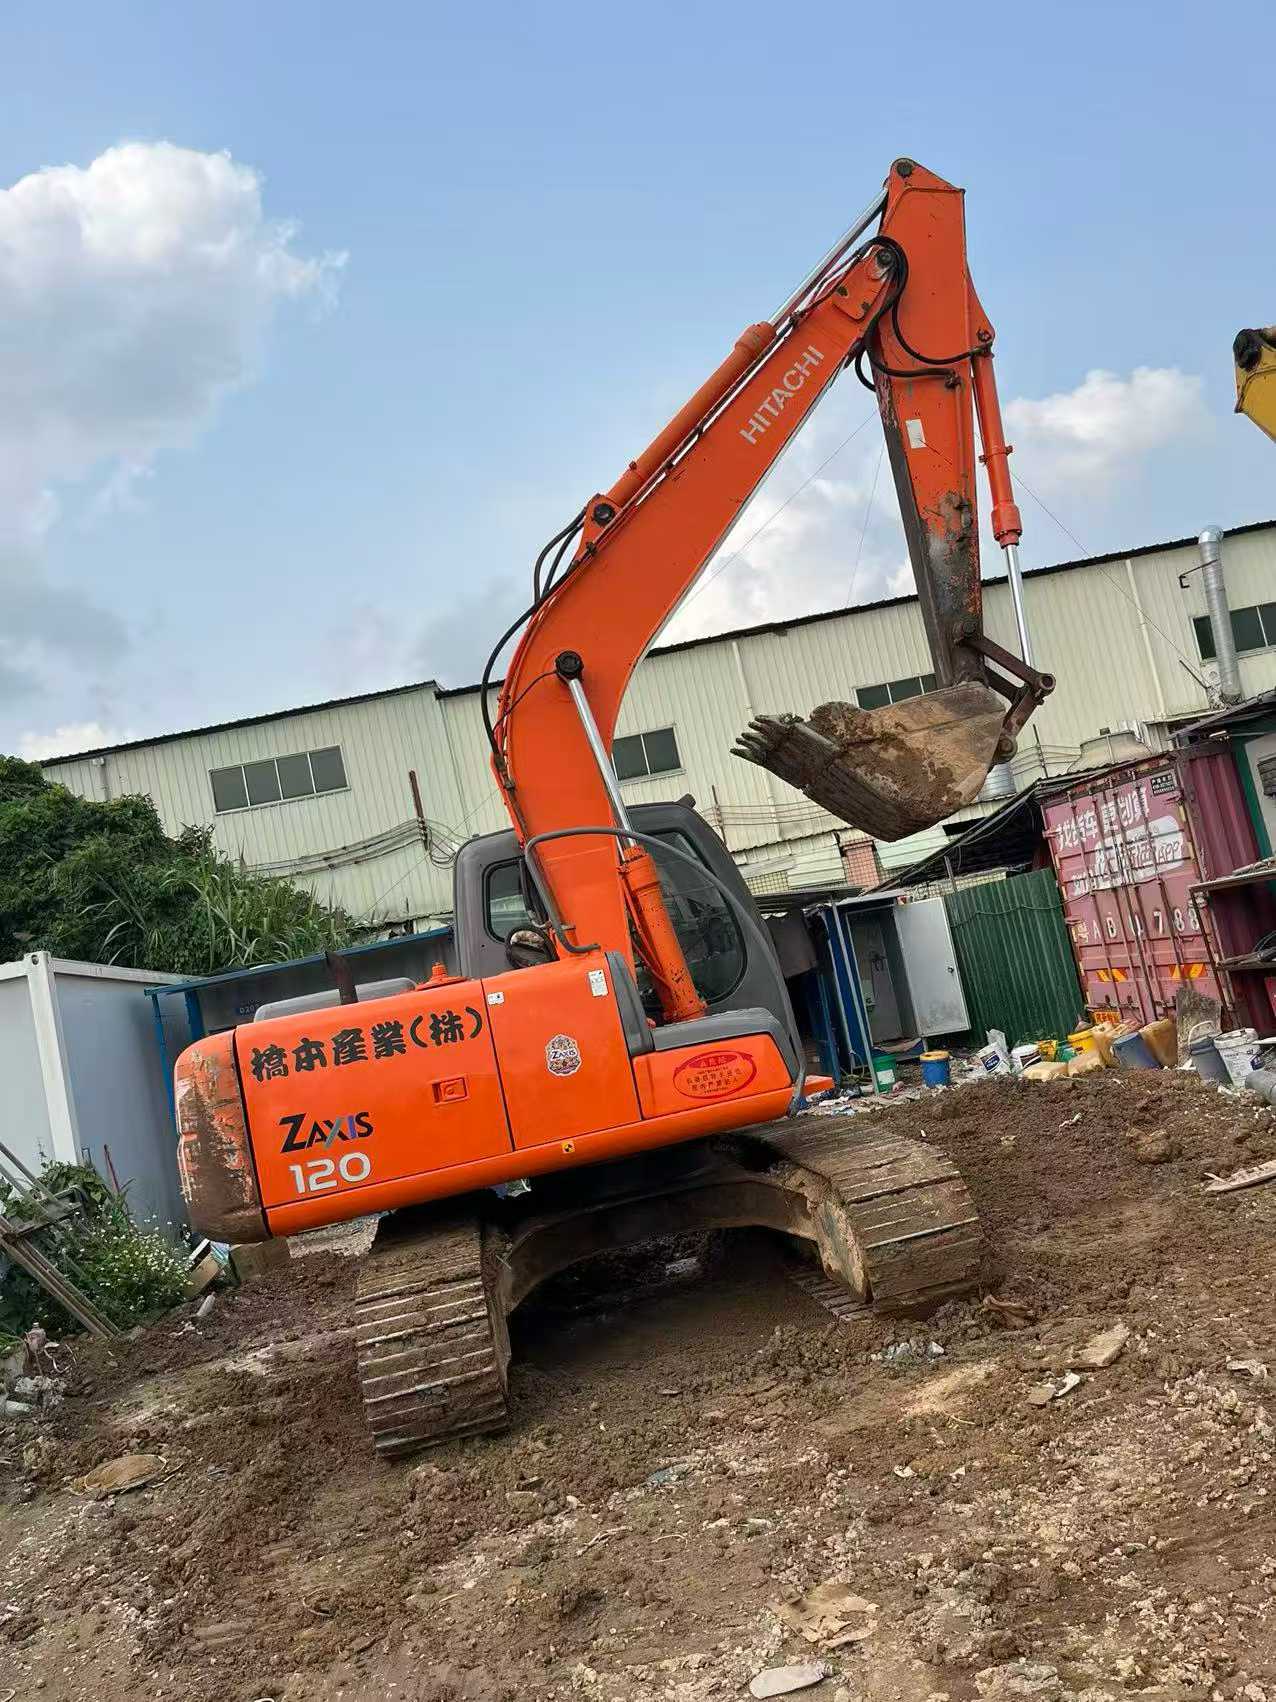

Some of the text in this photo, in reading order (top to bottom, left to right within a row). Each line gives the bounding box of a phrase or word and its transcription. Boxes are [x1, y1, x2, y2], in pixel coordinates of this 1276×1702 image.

[738, 345, 825, 445] HITACHI
[551, 1048, 577, 1060] ZAXIS
[278, 1111, 375, 1153] ZAXIS
[289, 1151, 372, 1194] 120
